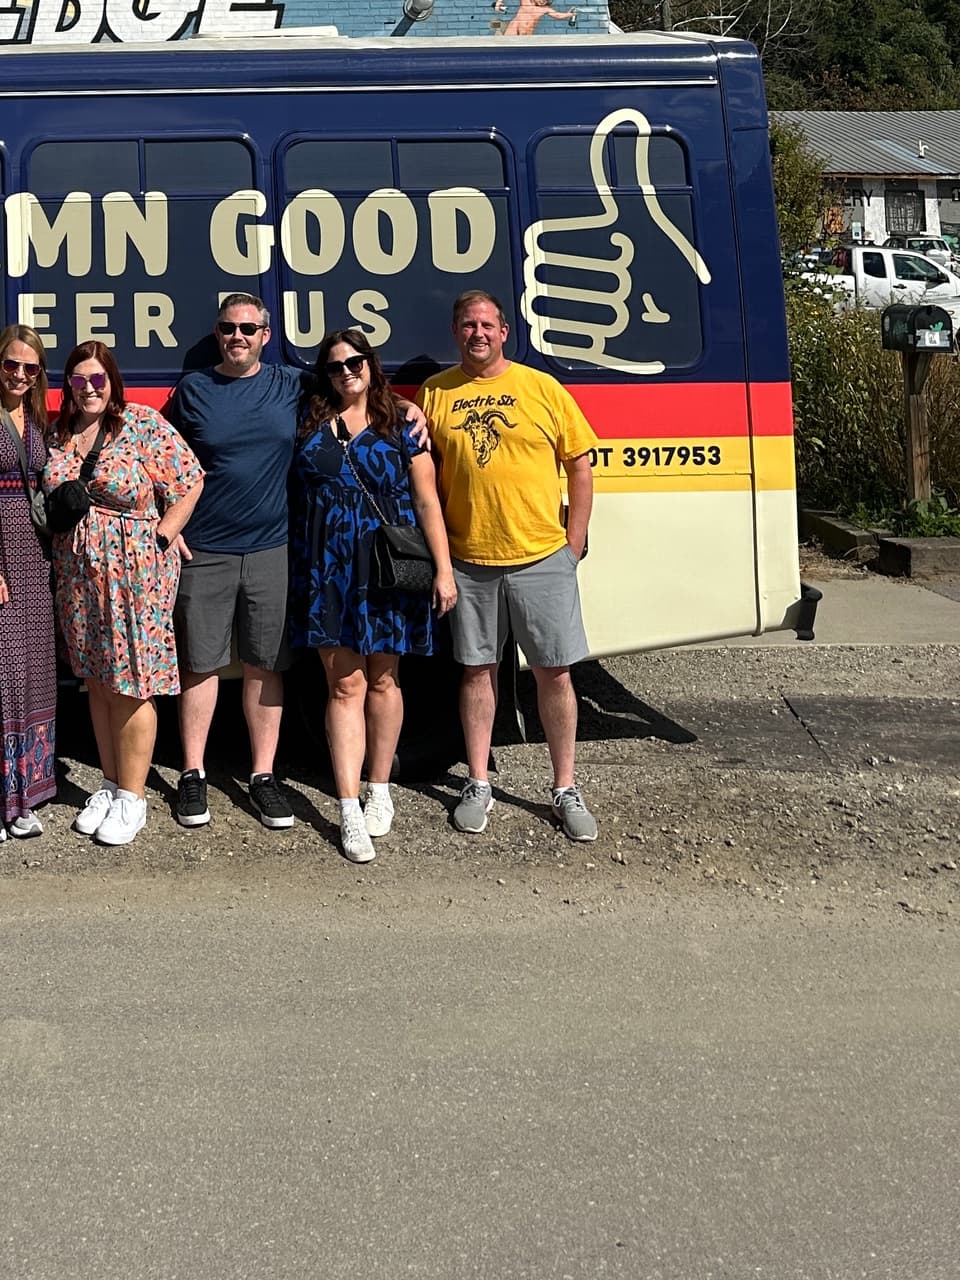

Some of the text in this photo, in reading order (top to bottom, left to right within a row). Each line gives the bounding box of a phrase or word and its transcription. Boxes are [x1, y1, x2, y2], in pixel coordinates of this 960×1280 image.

[209, 187, 496, 276] GOOD
[218, 289, 391, 348] US
[451, 394, 517, 413] Electric Six
[623, 445, 722, 467] 3917953
